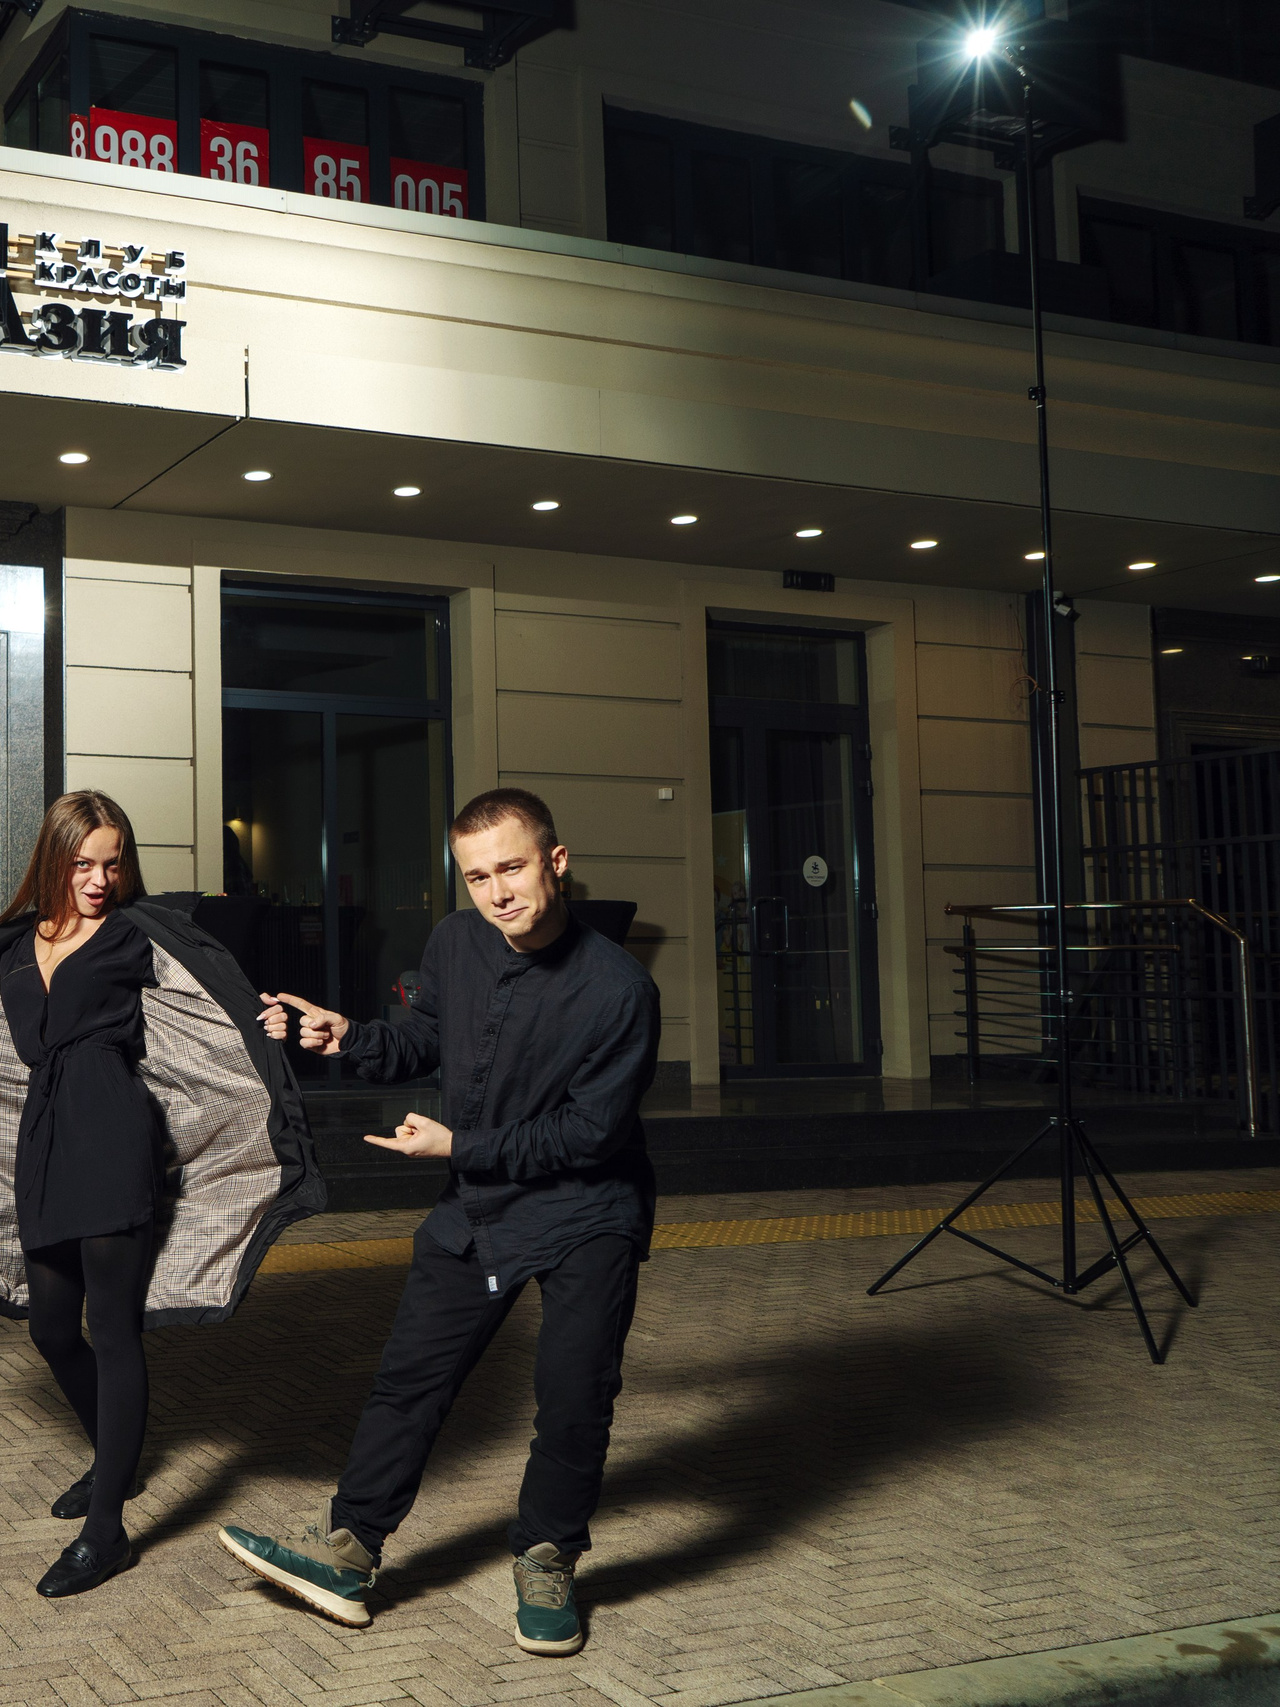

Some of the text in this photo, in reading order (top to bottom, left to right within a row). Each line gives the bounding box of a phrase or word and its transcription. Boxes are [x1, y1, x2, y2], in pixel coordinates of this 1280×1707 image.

[71, 120, 464, 219] 8 988 36 85 005
[35, 231, 187, 275] КЛУБ
[35, 260, 187, 304] КРАСОТЫ
